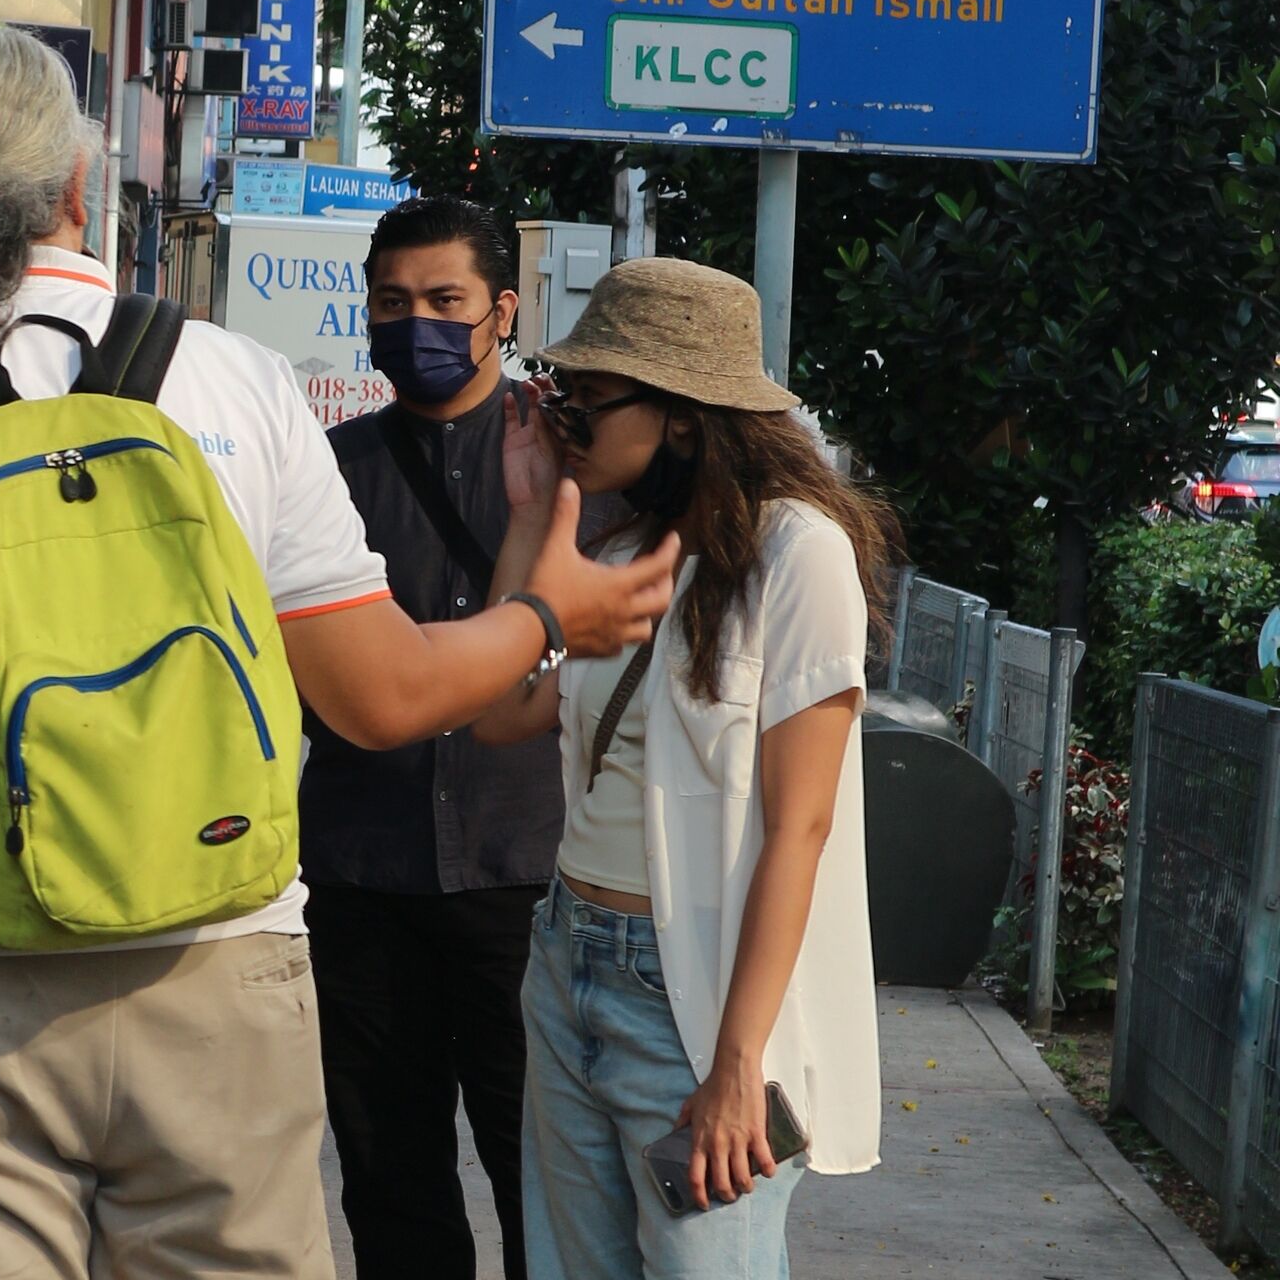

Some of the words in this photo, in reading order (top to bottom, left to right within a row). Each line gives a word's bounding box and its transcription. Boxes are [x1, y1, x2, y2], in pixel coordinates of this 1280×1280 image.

[634, 44, 769, 89] KLCC
[240, 98, 309, 120] X-RAY
[310, 175, 360, 197] LALUAN
